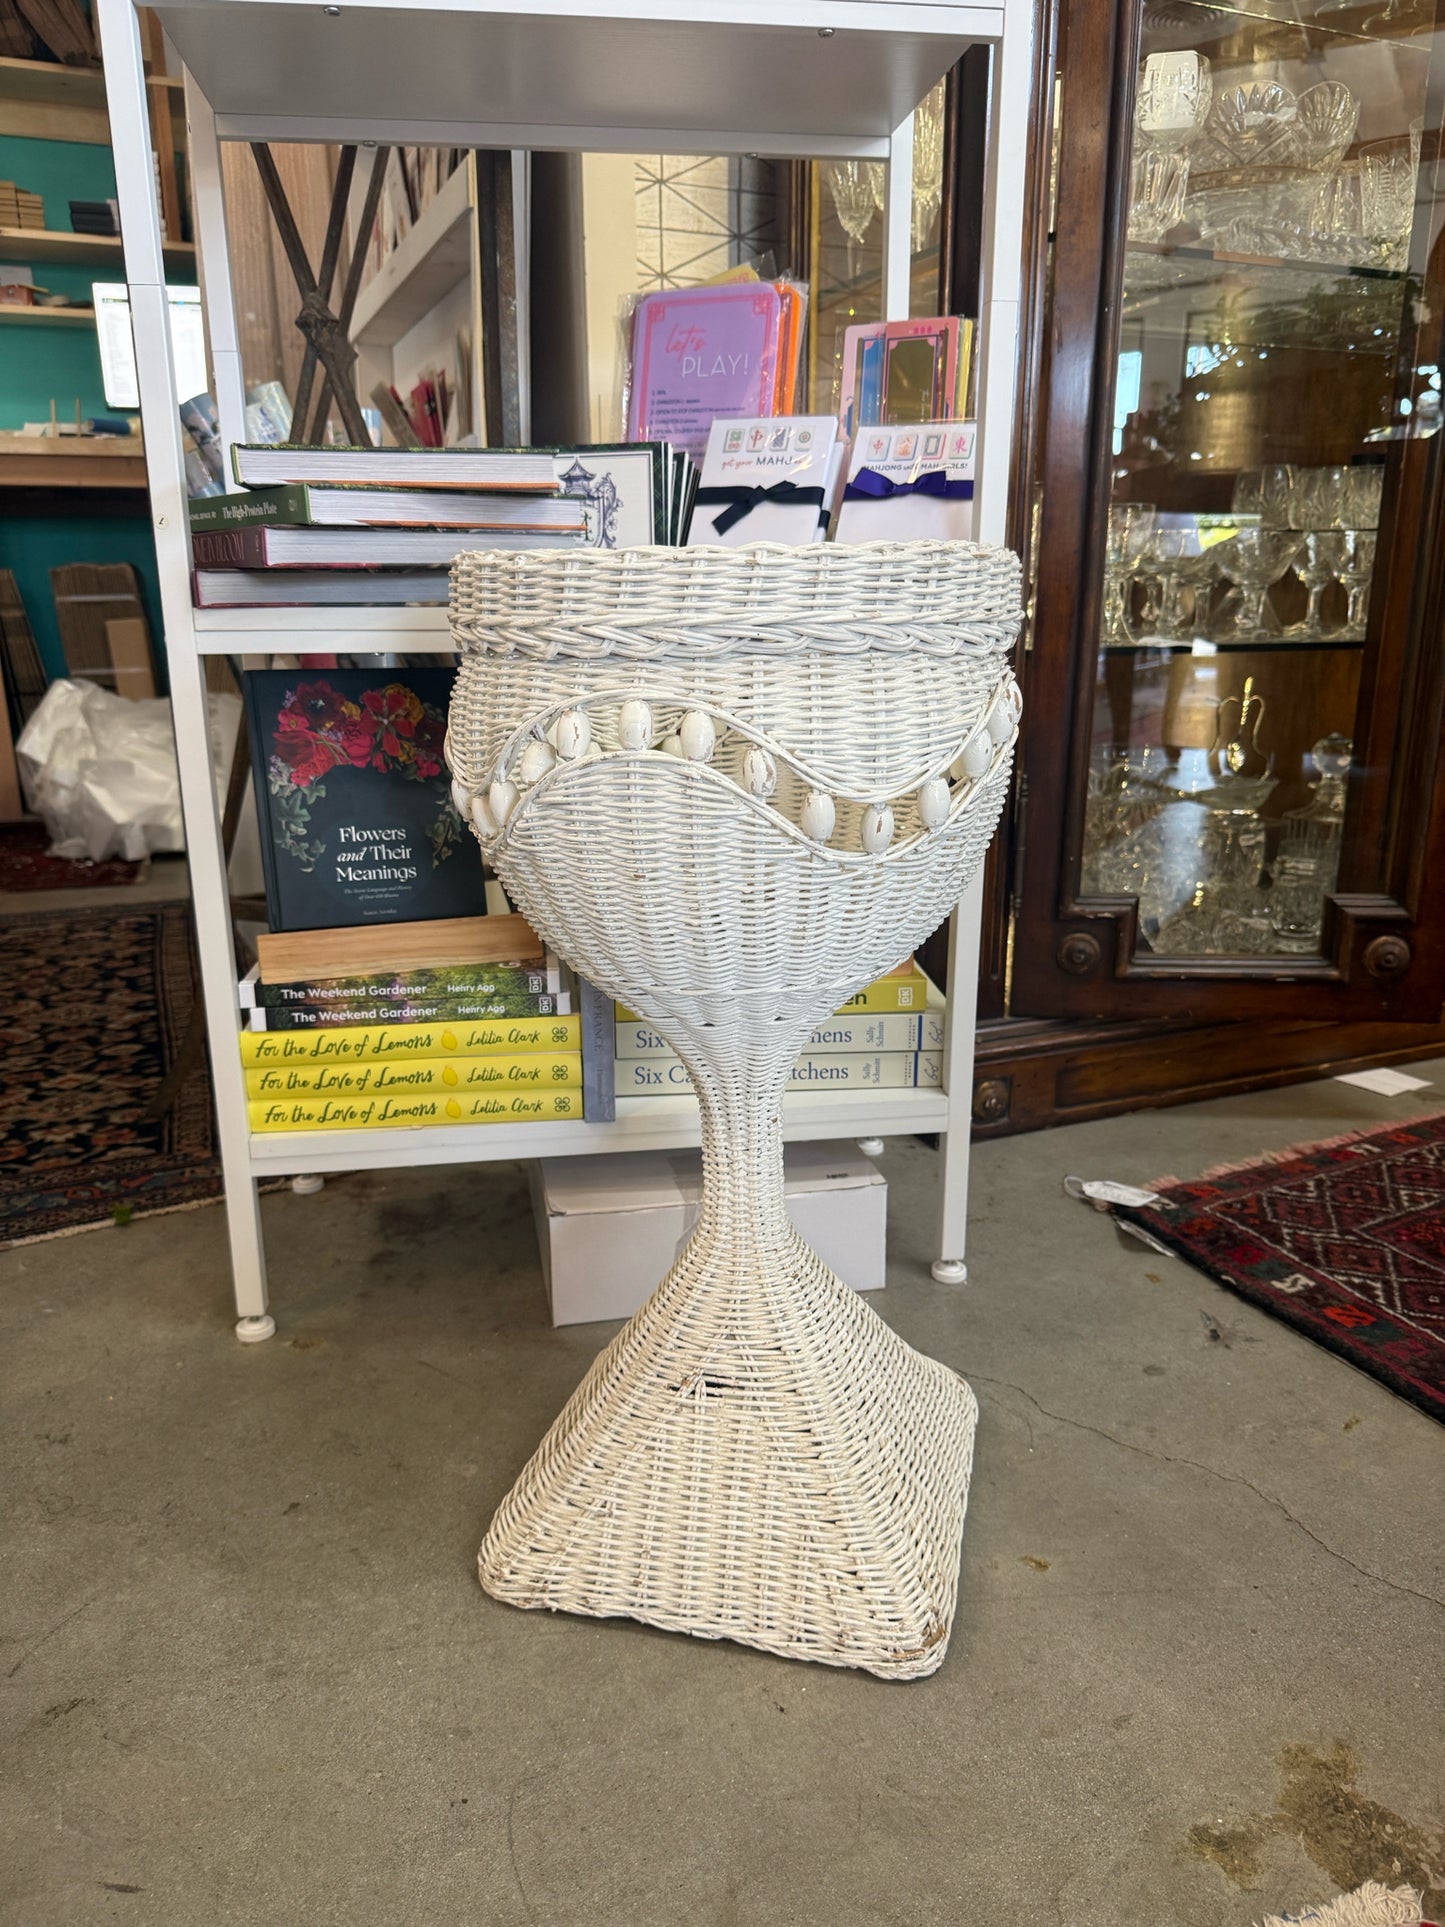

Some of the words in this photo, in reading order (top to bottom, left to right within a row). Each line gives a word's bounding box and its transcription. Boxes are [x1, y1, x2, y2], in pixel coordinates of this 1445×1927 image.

[682, 353, 749, 378] PLAY!
[756, 456, 793, 466] MAHJ
[232, 503, 263, 521] High-Protein
[339, 826, 406, 842] Flowers
[337, 847, 367, 862] and
[369, 844, 412, 860] Their
[336, 865, 417, 882] Meanings
[280, 989, 305, 999] The
[308, 986, 366, 998] Weekend
[369, 984, 426, 996] Gardener
[447, 984, 475, 993] Henry
[477, 983, 495, 993] Agg
[292, 1012, 316, 1023] The
[318, 1009, 377, 1021] Weekend
[379, 1006, 438, 1019] Gardener
[458, 1004, 486, 1014] Henry
[487, 1004, 505, 1013] Agg
[593, 1005, 606, 1052] FRANCE
[636, 1030, 665, 1049] Six
[866, 1026, 876, 1043] Sally
[256, 1038, 279, 1058] For
[283, 1039, 306, 1057] the
[310, 1035, 351, 1057] Love
[354, 1034, 369, 1057] of
[372, 1032, 434, 1054] Lemons
[466, 1030, 503, 1047] Letitia
[508, 1028, 541, 1044] Clark
[260, 1071, 283, 1090] For
[287, 1071, 309, 1090] the
[313, 1068, 353, 1090] Love
[356, 1068, 371, 1091] of
[374, 1066, 435, 1087] Lemons
[467, 1066, 504, 1083] Letitia
[508, 1065, 541, 1081] Clark
[634, 1066, 663, 1085] Six
[789, 1062, 849, 1080] tchens
[862, 1063, 873, 1080] Sally
[265, 1104, 288, 1124] For
[292, 1104, 314, 1123] the
[317, 1101, 357, 1123] Love
[360, 1101, 375, 1123] of
[378, 1099, 438, 1120] Lemons
[470, 1099, 507, 1115] Letitia
[511, 1097, 544, 1112] Clark
